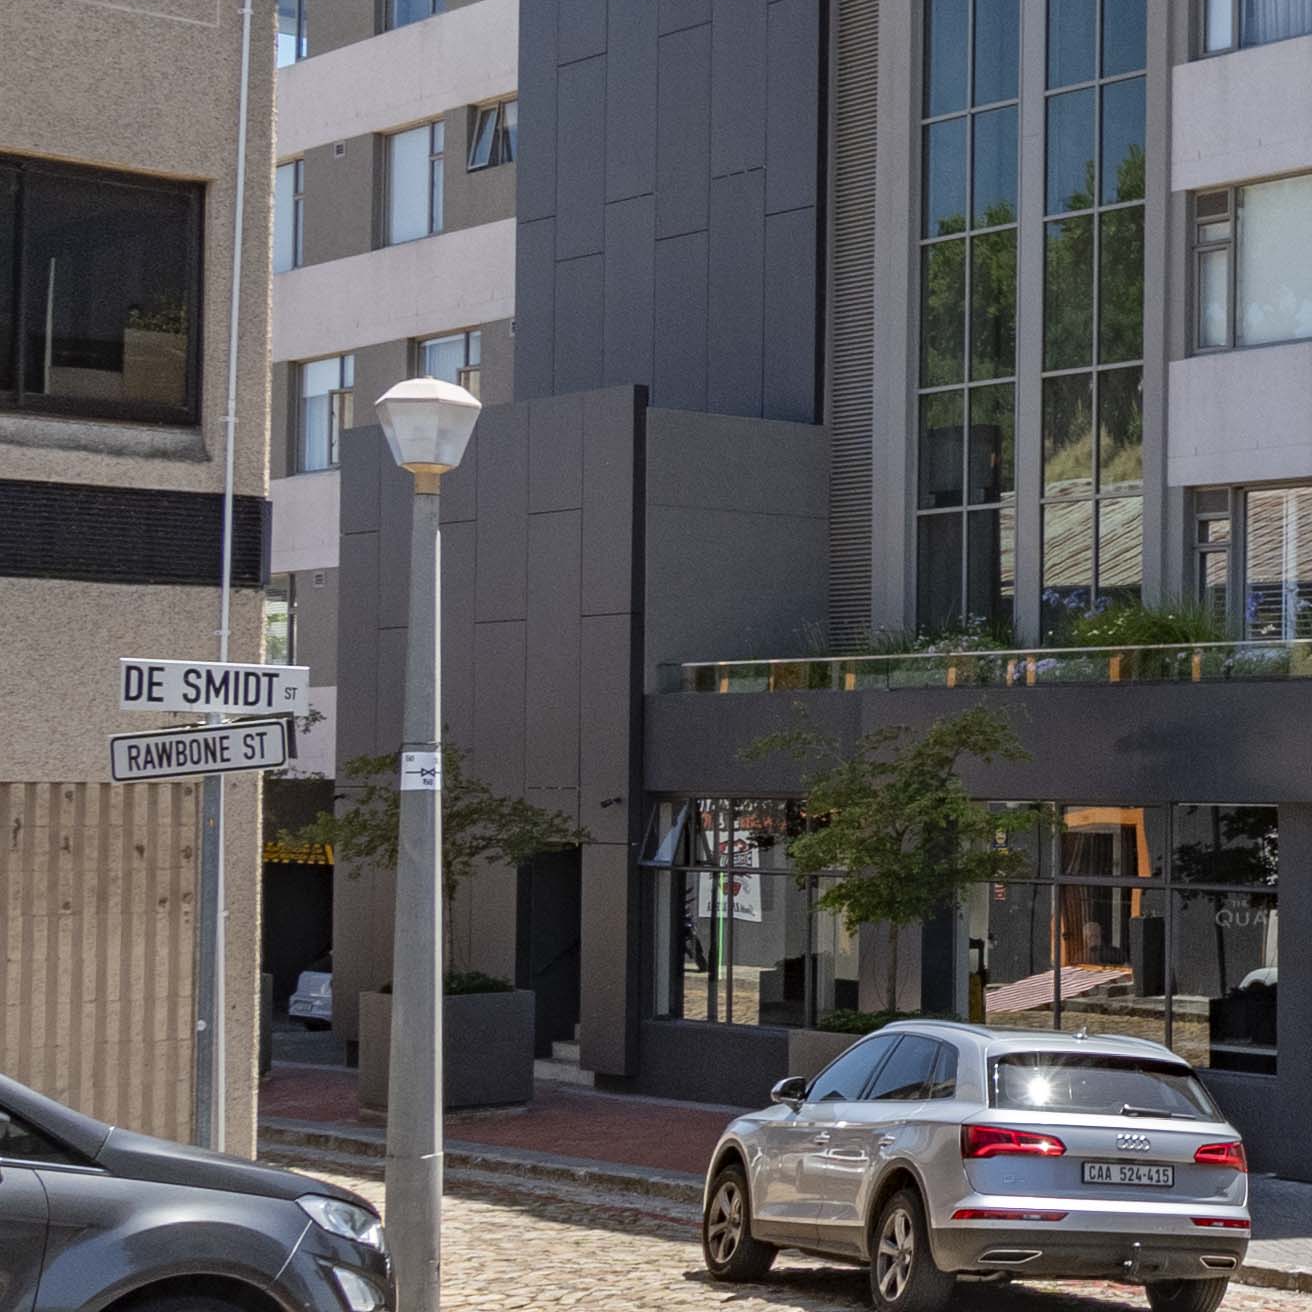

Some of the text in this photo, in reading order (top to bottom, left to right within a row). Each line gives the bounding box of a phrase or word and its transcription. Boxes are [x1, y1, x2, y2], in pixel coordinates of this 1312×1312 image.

[124, 665, 298, 707] DE SMIDT ST
[127, 732, 267, 772] RAWBONE ST
[1088, 1166, 1112, 1182] CAA
